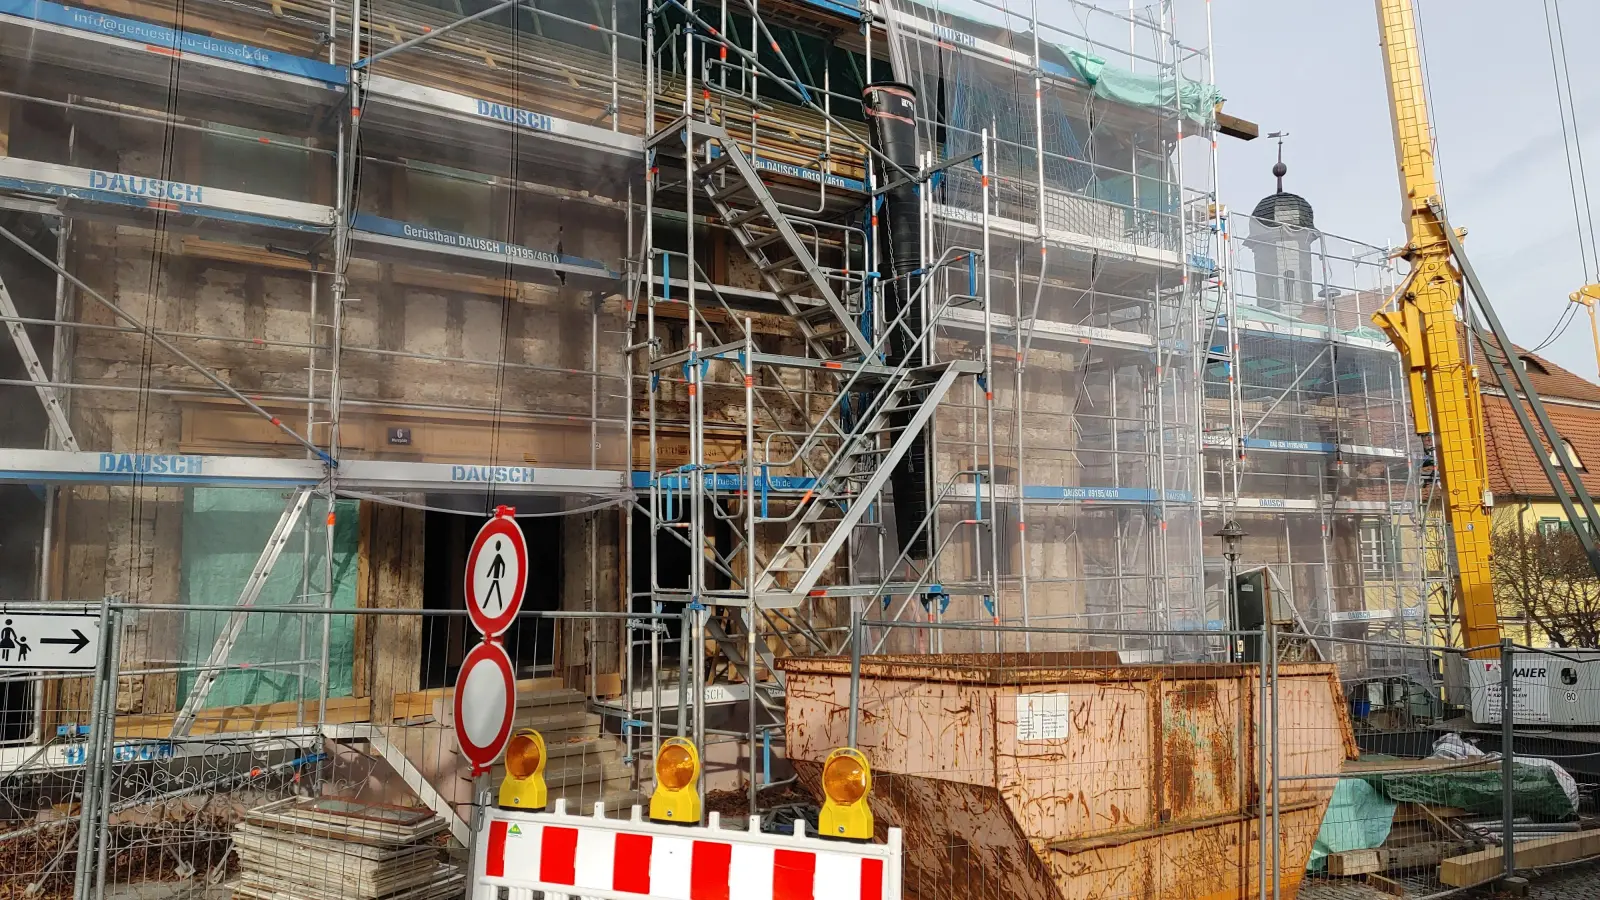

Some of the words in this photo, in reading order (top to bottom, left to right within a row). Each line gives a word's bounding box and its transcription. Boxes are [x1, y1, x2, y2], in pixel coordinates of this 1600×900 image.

[74, 11, 270, 63] info@geruestbau-dausch.de
[477, 100, 552, 130] DAUSCH
[766, 161, 799, 177] DAUSCH
[802, 170, 845, 187] 0919/4610
[89, 170, 203, 203] DAUSCH
[403, 224, 456, 245] Gerüstbau
[458, 235, 500, 254] DAUSCH
[505, 245, 560, 263] 09195/4610
[396, 429, 403, 438] 6
[102, 452, 203, 475] DAUSCH
[451, 465, 536, 483] DAUSCH
[1063, 488, 1086, 498] DAUSCH
[1566, 692, 1577, 701] 80
